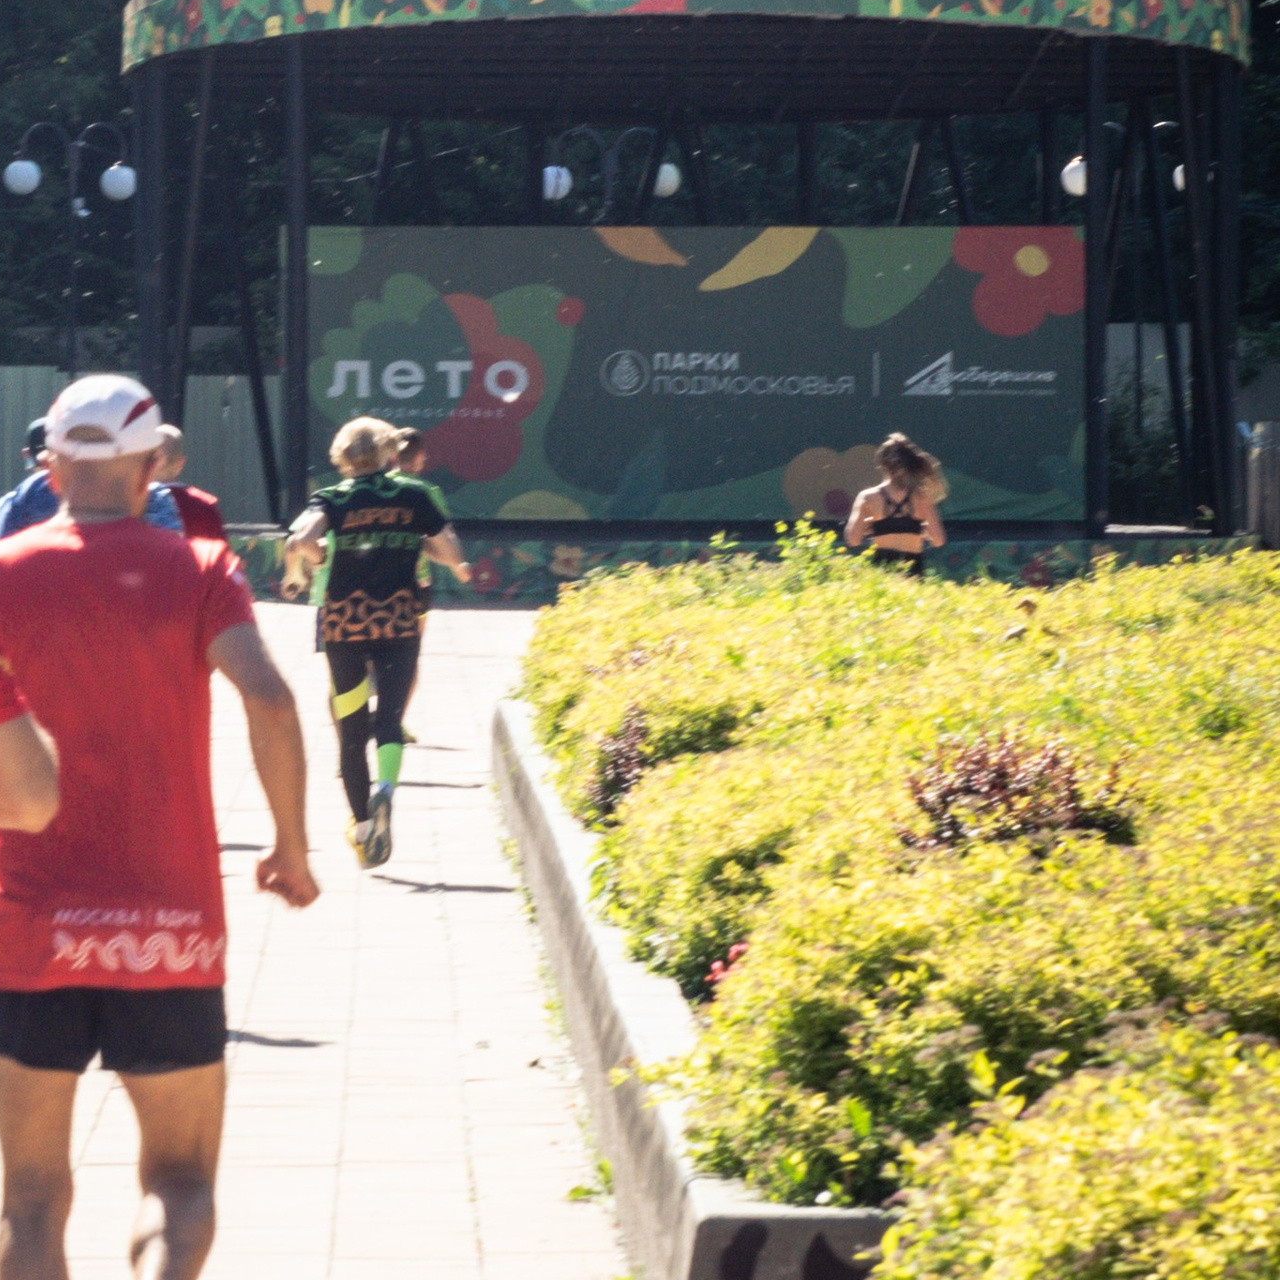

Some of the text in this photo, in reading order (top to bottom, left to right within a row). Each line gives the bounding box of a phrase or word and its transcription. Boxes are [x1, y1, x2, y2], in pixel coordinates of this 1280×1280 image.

[651, 352, 740, 371] ПАРКИ
[651, 376, 855, 395] ПОДМОСКОВЬЯ
[53, 908, 140, 927] МОСКВА
